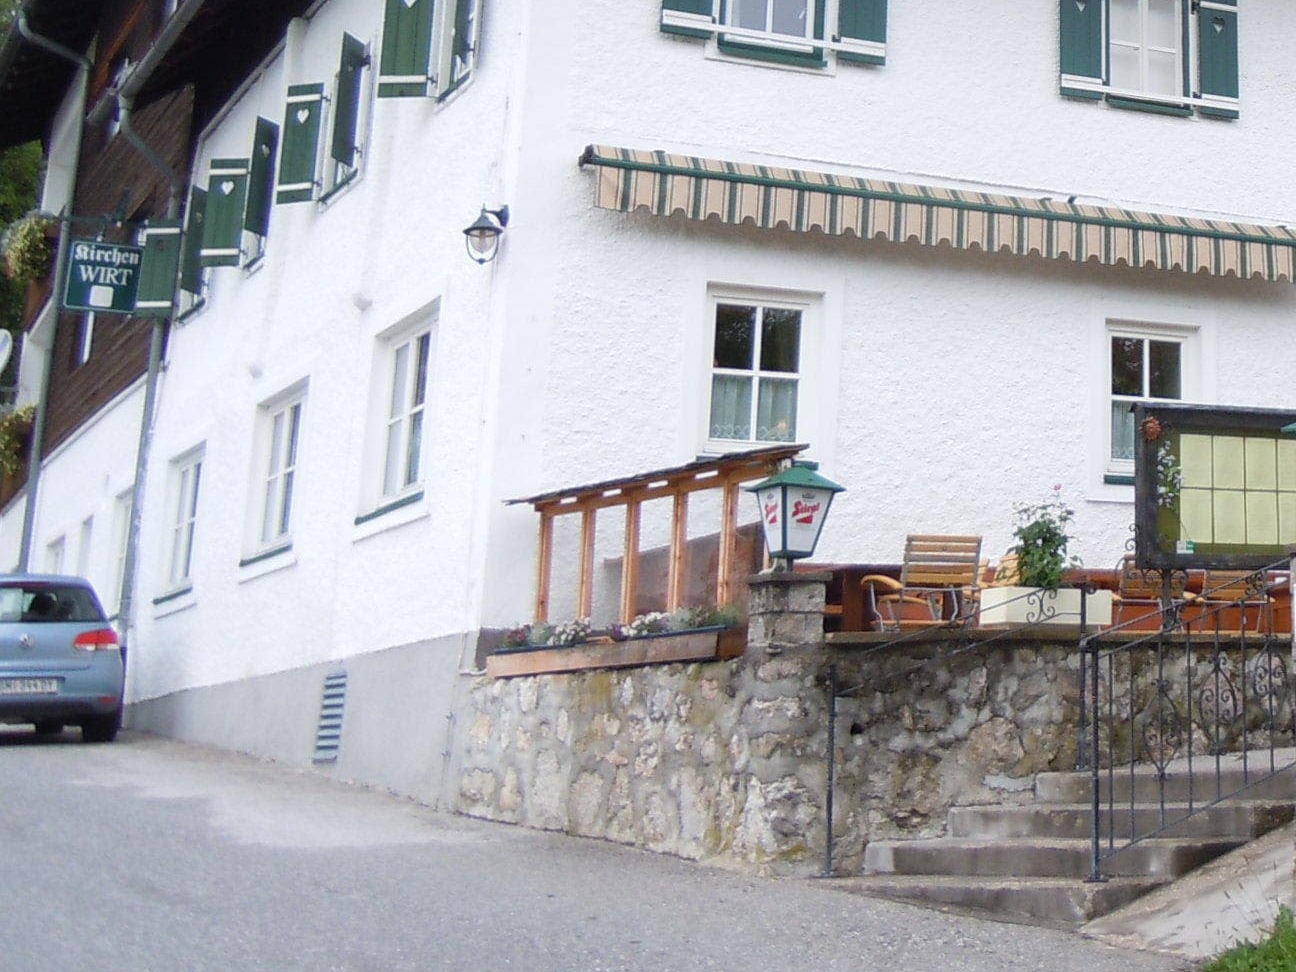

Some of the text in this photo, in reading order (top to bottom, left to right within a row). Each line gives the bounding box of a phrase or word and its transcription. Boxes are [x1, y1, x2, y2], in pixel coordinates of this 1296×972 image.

[75, 244, 139, 267] Kirchen
[80, 265, 133, 285] WIRT
[792, 500, 820, 517] Stiegl
